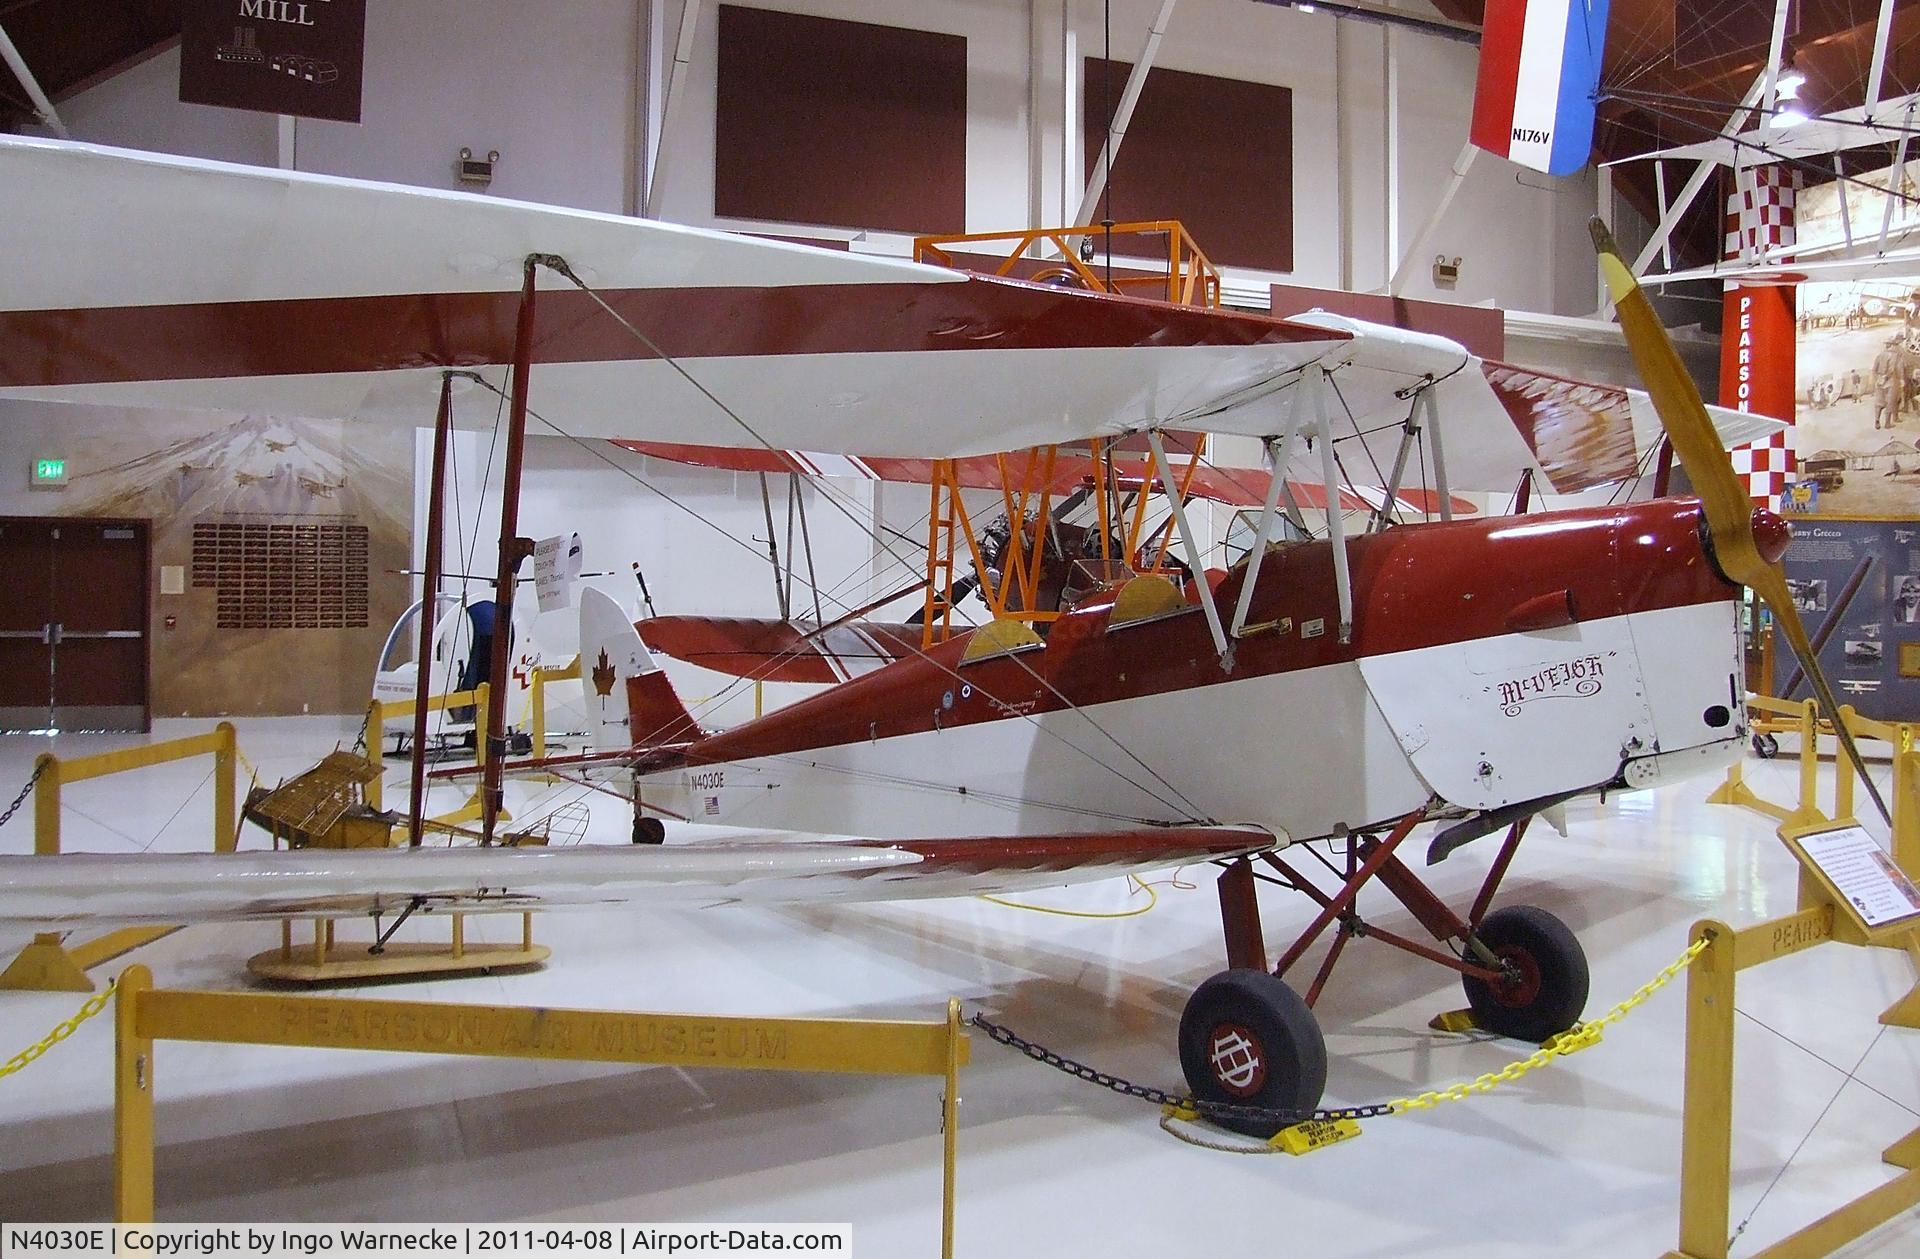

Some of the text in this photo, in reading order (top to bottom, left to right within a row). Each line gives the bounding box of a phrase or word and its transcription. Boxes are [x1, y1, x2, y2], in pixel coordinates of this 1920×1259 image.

[239, 0, 315, 26] MILL
[1512, 127, 1550, 145] N176V
[1738, 297, 1751, 414] PEARSON
[691, 772, 724, 791] N4030E
[278, 1003, 788, 1061] PEARSON AIR MUSEUM
